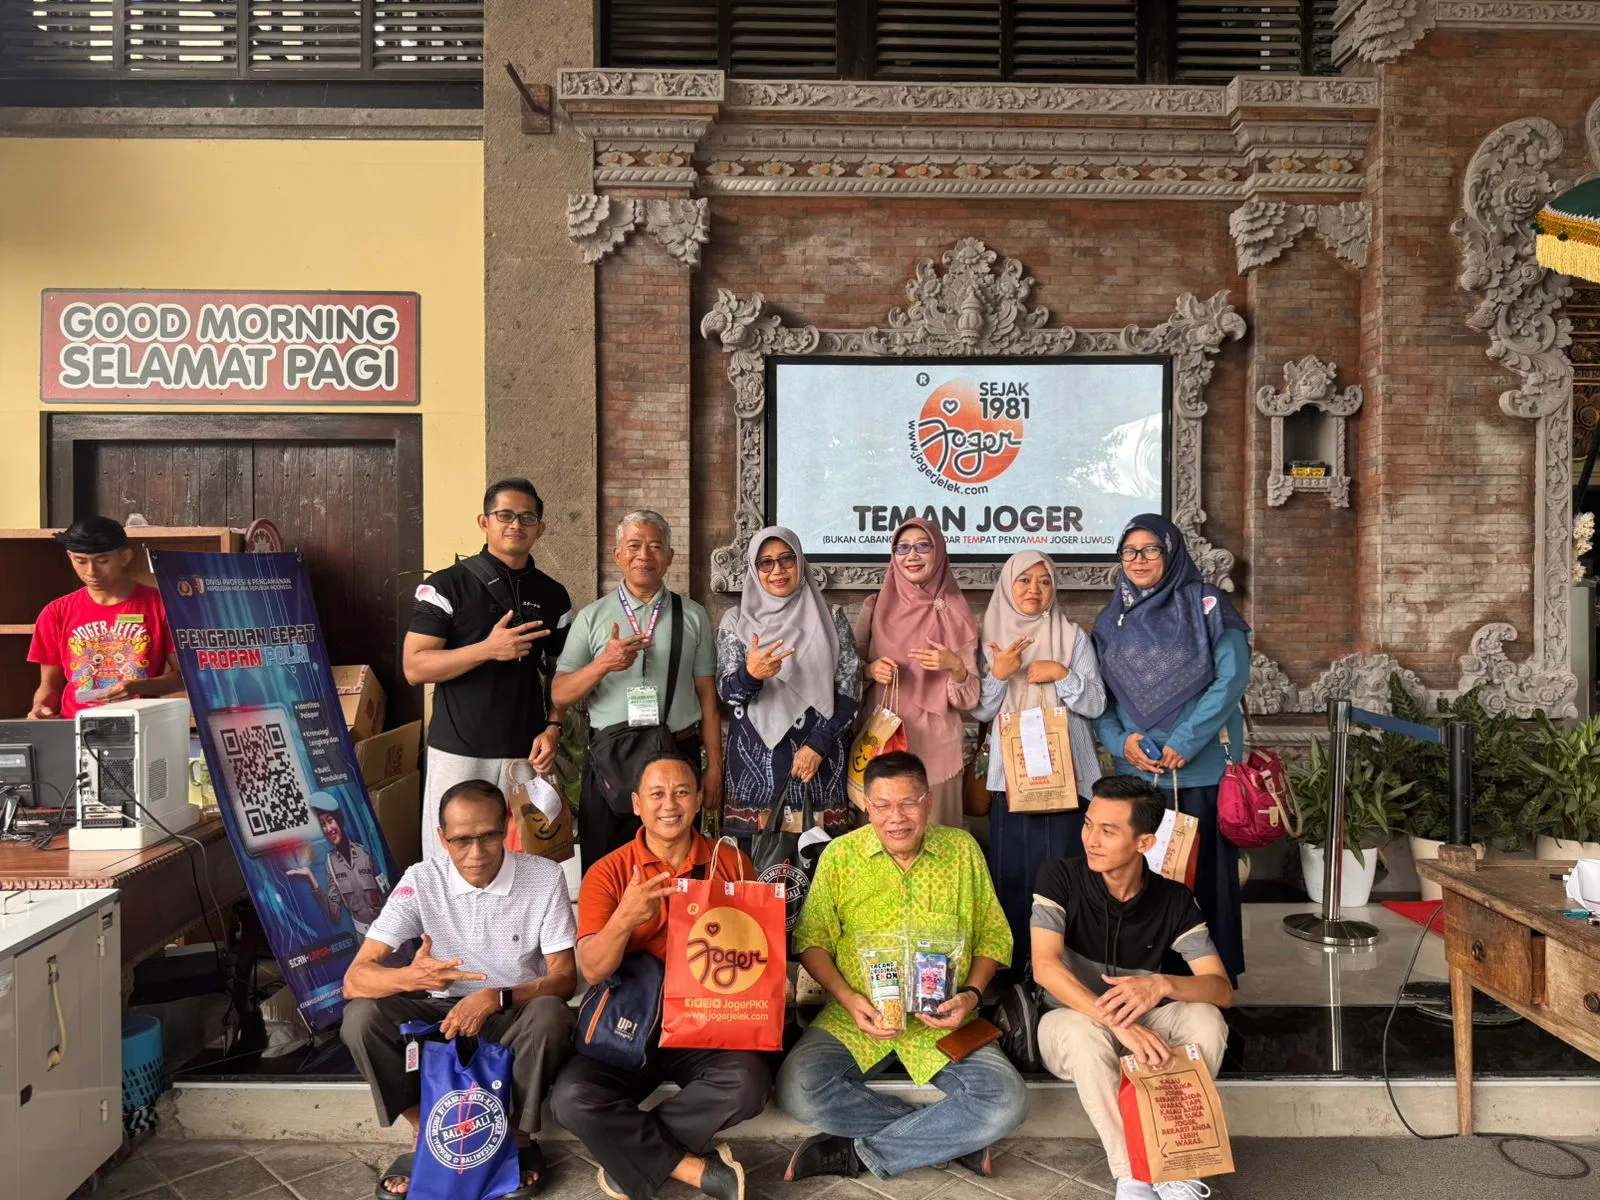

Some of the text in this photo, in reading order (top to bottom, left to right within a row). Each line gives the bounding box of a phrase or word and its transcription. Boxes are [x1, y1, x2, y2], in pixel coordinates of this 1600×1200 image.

[60, 303, 399, 344] GOOD MORNING
[59, 343, 399, 391] SELAMAT PAGI
[979, 382, 1030, 396] SEJAK
[979, 397, 1030, 420] 1981
[908, 420, 989, 495] www.jogerjelek.com
[918, 419, 1022, 476] Joger
[976, 505, 1083, 532] JOGER
[822, 535, 856, 545] (BUKAN
[963, 535, 996, 544] TEMPAT
[998, 535, 1048, 544] PENYAMAN
[1049, 535, 1078, 544] JOGER
[72, 620, 108, 640] JOGER
[176, 624, 316, 649] PENGADUAN CEPAT
[197, 643, 310, 670] PROPAM POLRI
[687, 938, 768, 988] Joger
[722, 999, 769, 1010] JogerPKK
[1181, 1092, 1202, 1101] ANDA
[1160, 1105, 1204, 1116] KALAU ANDA
[1184, 1111, 1204, 1119] SUKA
[1191, 1123, 1211, 1131] ANDA
[461, 1144, 494, 1164] BALINESIA
